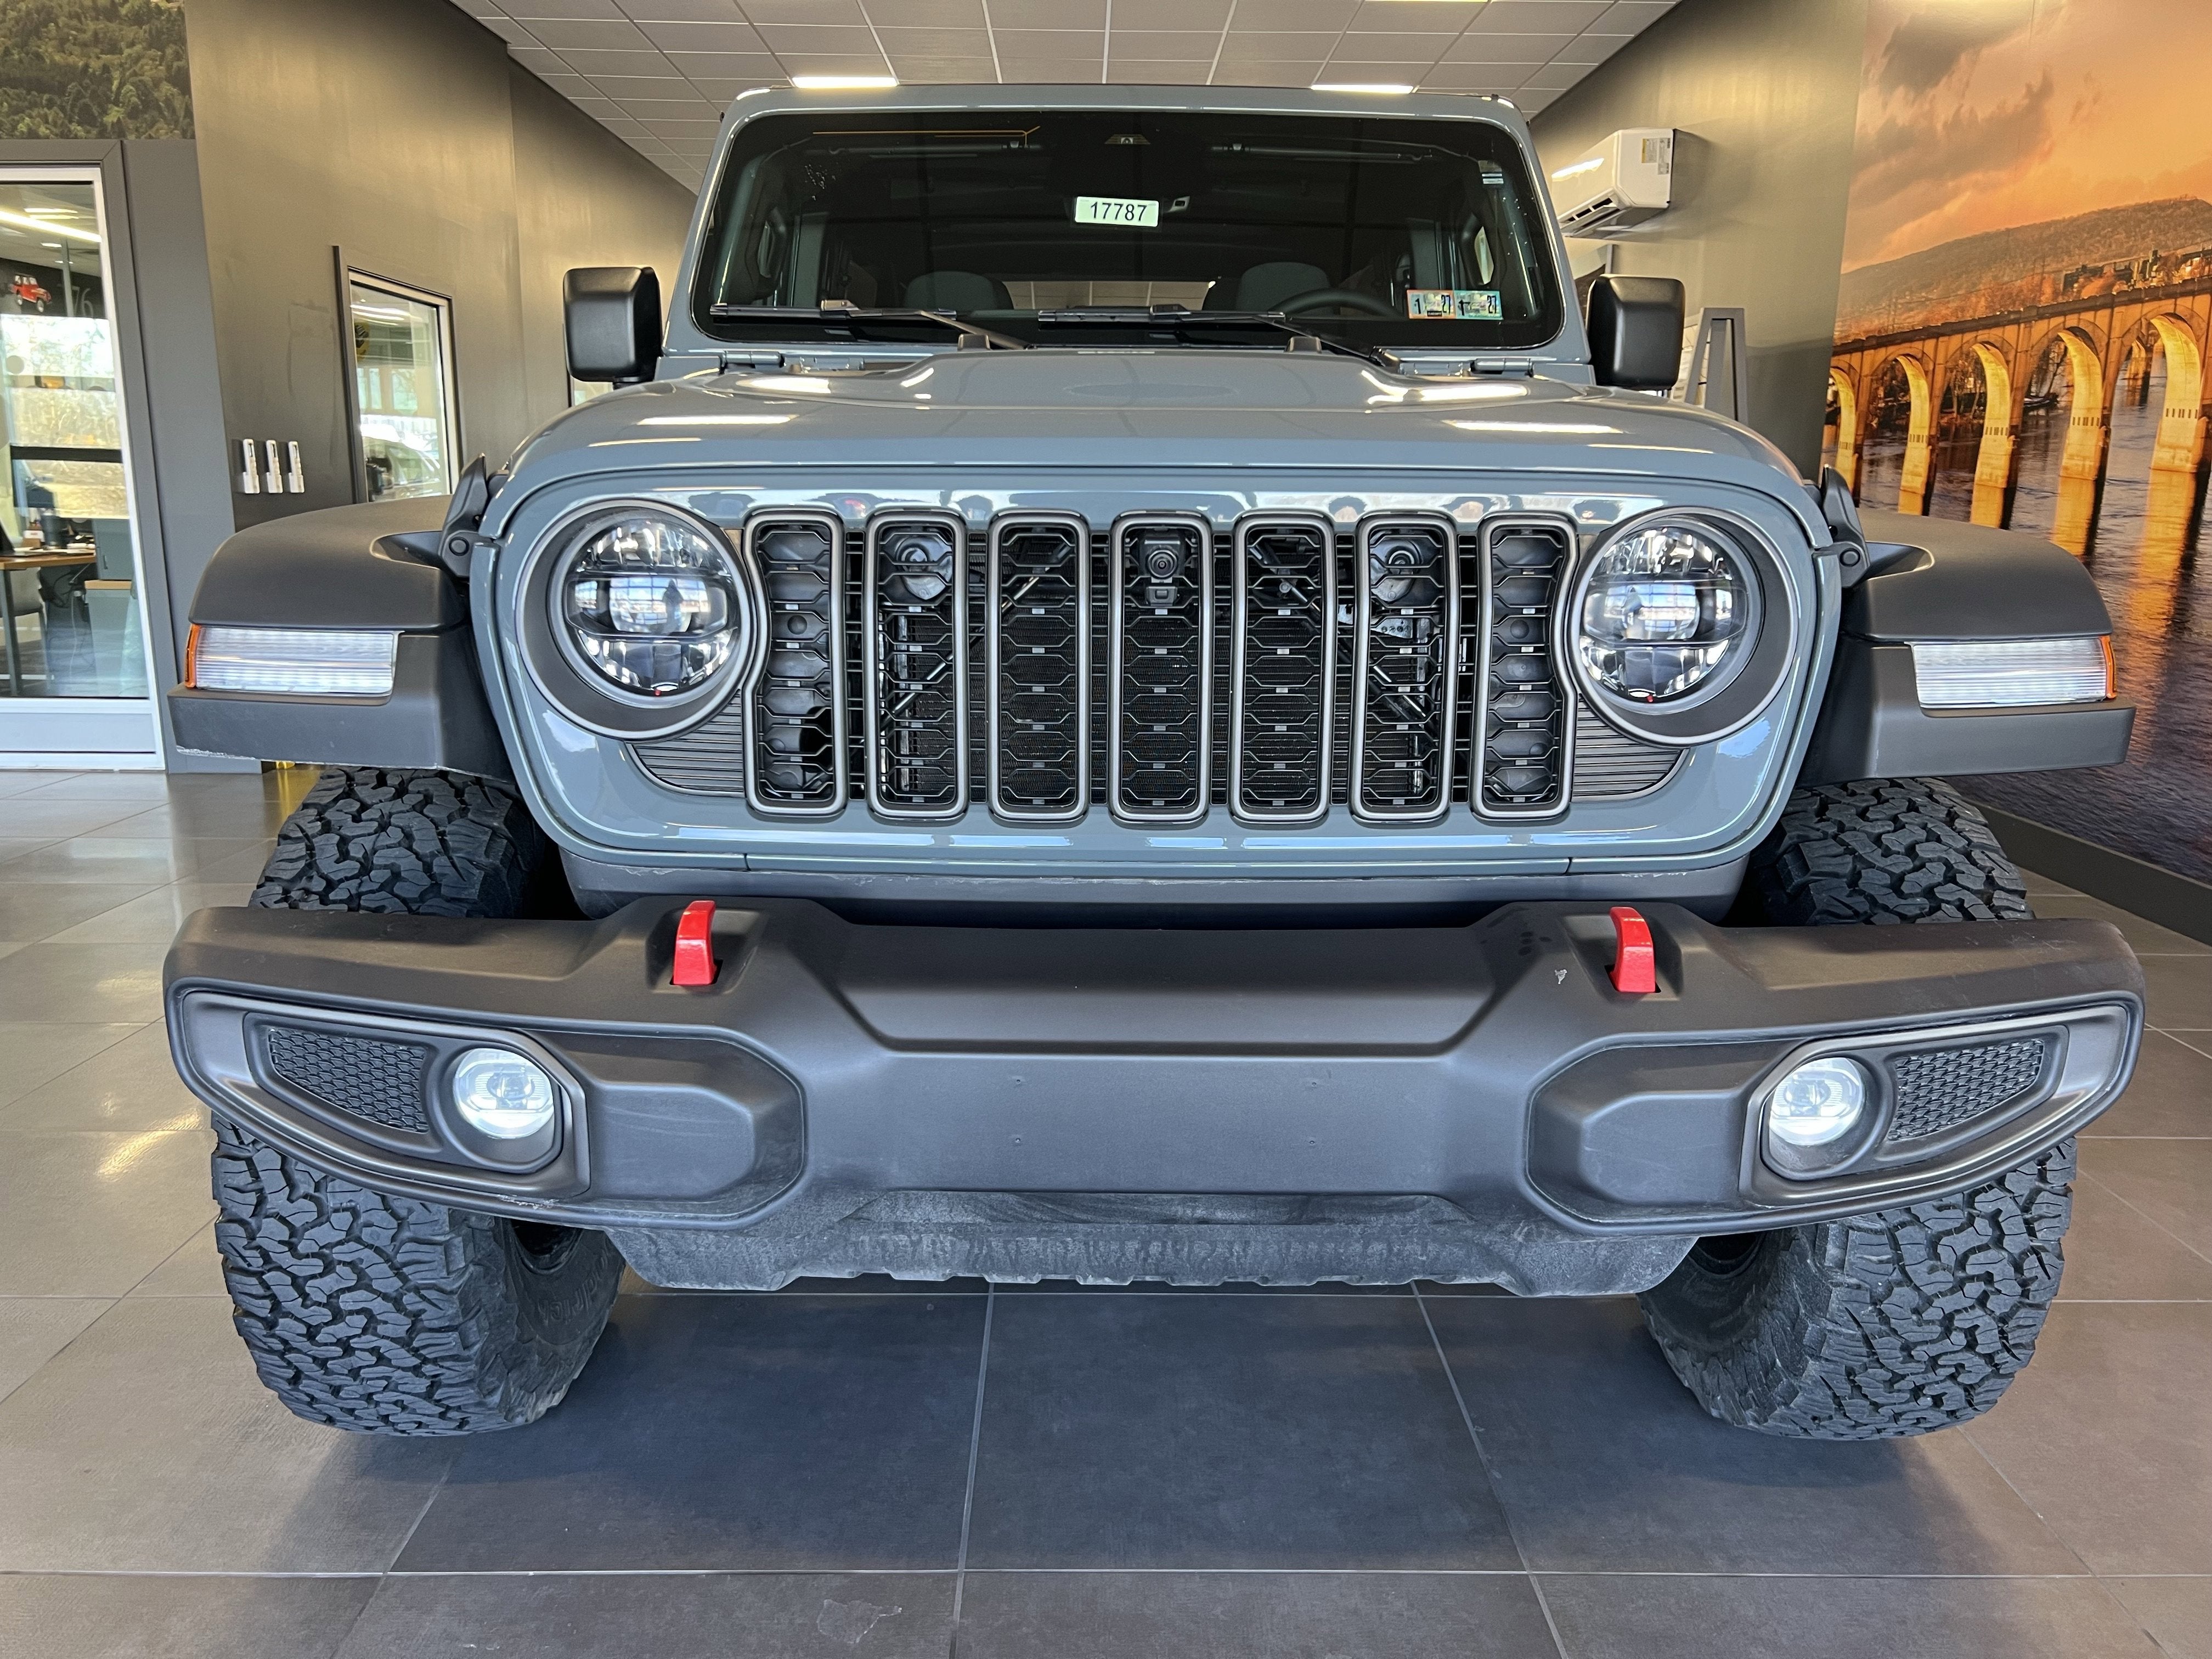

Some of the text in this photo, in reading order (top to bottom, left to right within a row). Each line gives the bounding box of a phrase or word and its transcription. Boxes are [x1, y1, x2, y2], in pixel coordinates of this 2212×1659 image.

[1090, 201, 1148, 222] 17787
[1441, 294, 1451, 315] 27
[1487, 295, 1497, 314] 27
